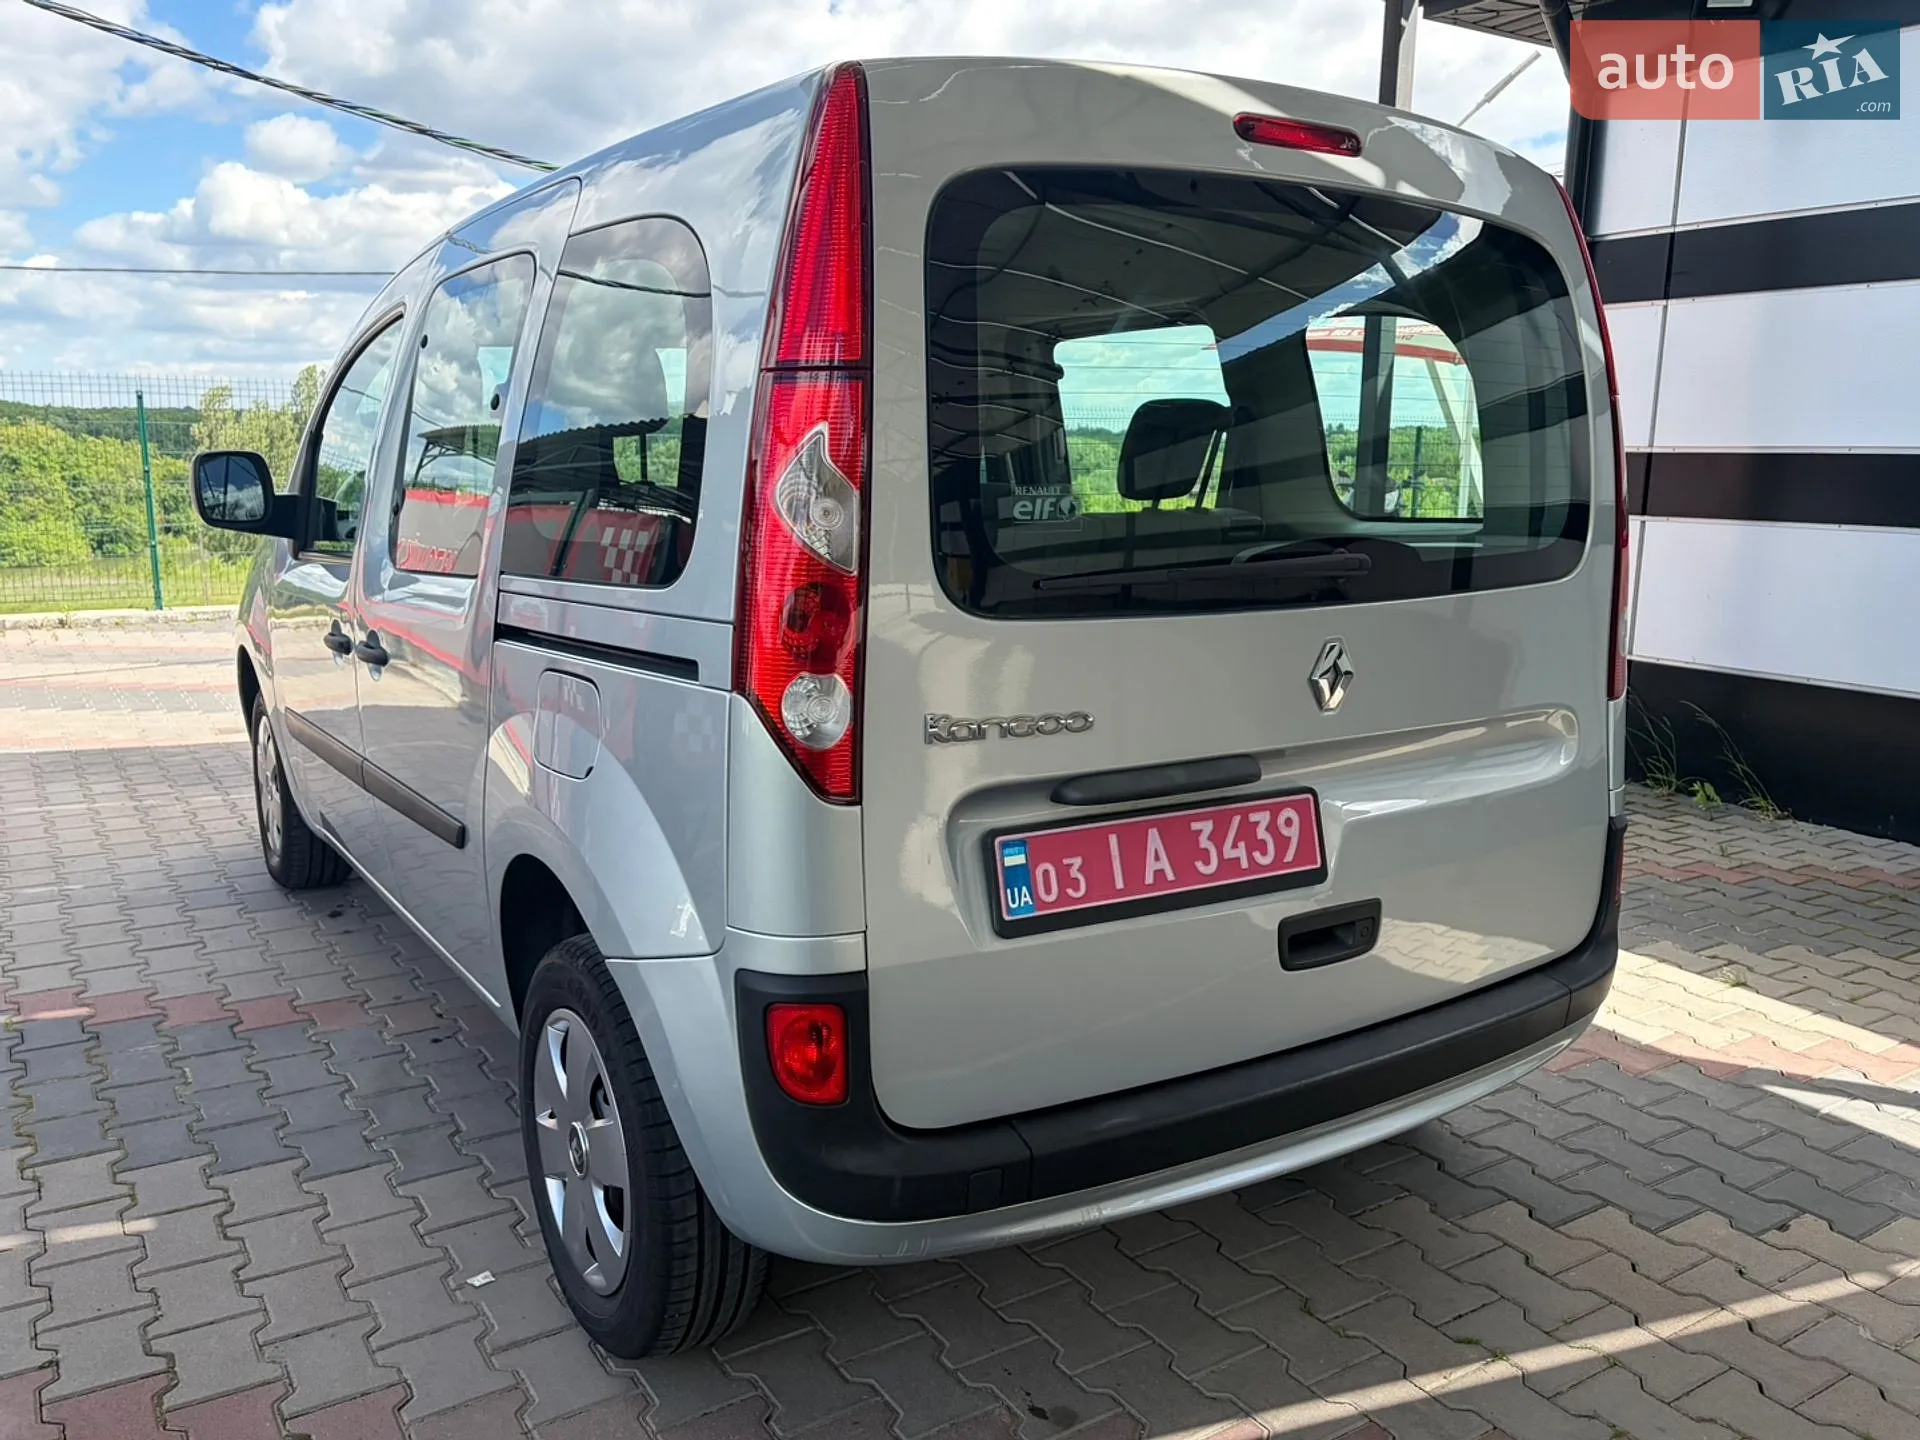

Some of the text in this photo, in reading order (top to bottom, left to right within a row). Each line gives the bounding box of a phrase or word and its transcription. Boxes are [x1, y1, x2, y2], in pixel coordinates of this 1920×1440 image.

[1015, 486, 1061, 495] RENAULT
[1013, 497, 1056, 520] elf
[1035, 856, 1087, 904] 03
[1190, 807, 1301, 876] 3439
[1006, 886, 1033, 909] UA
